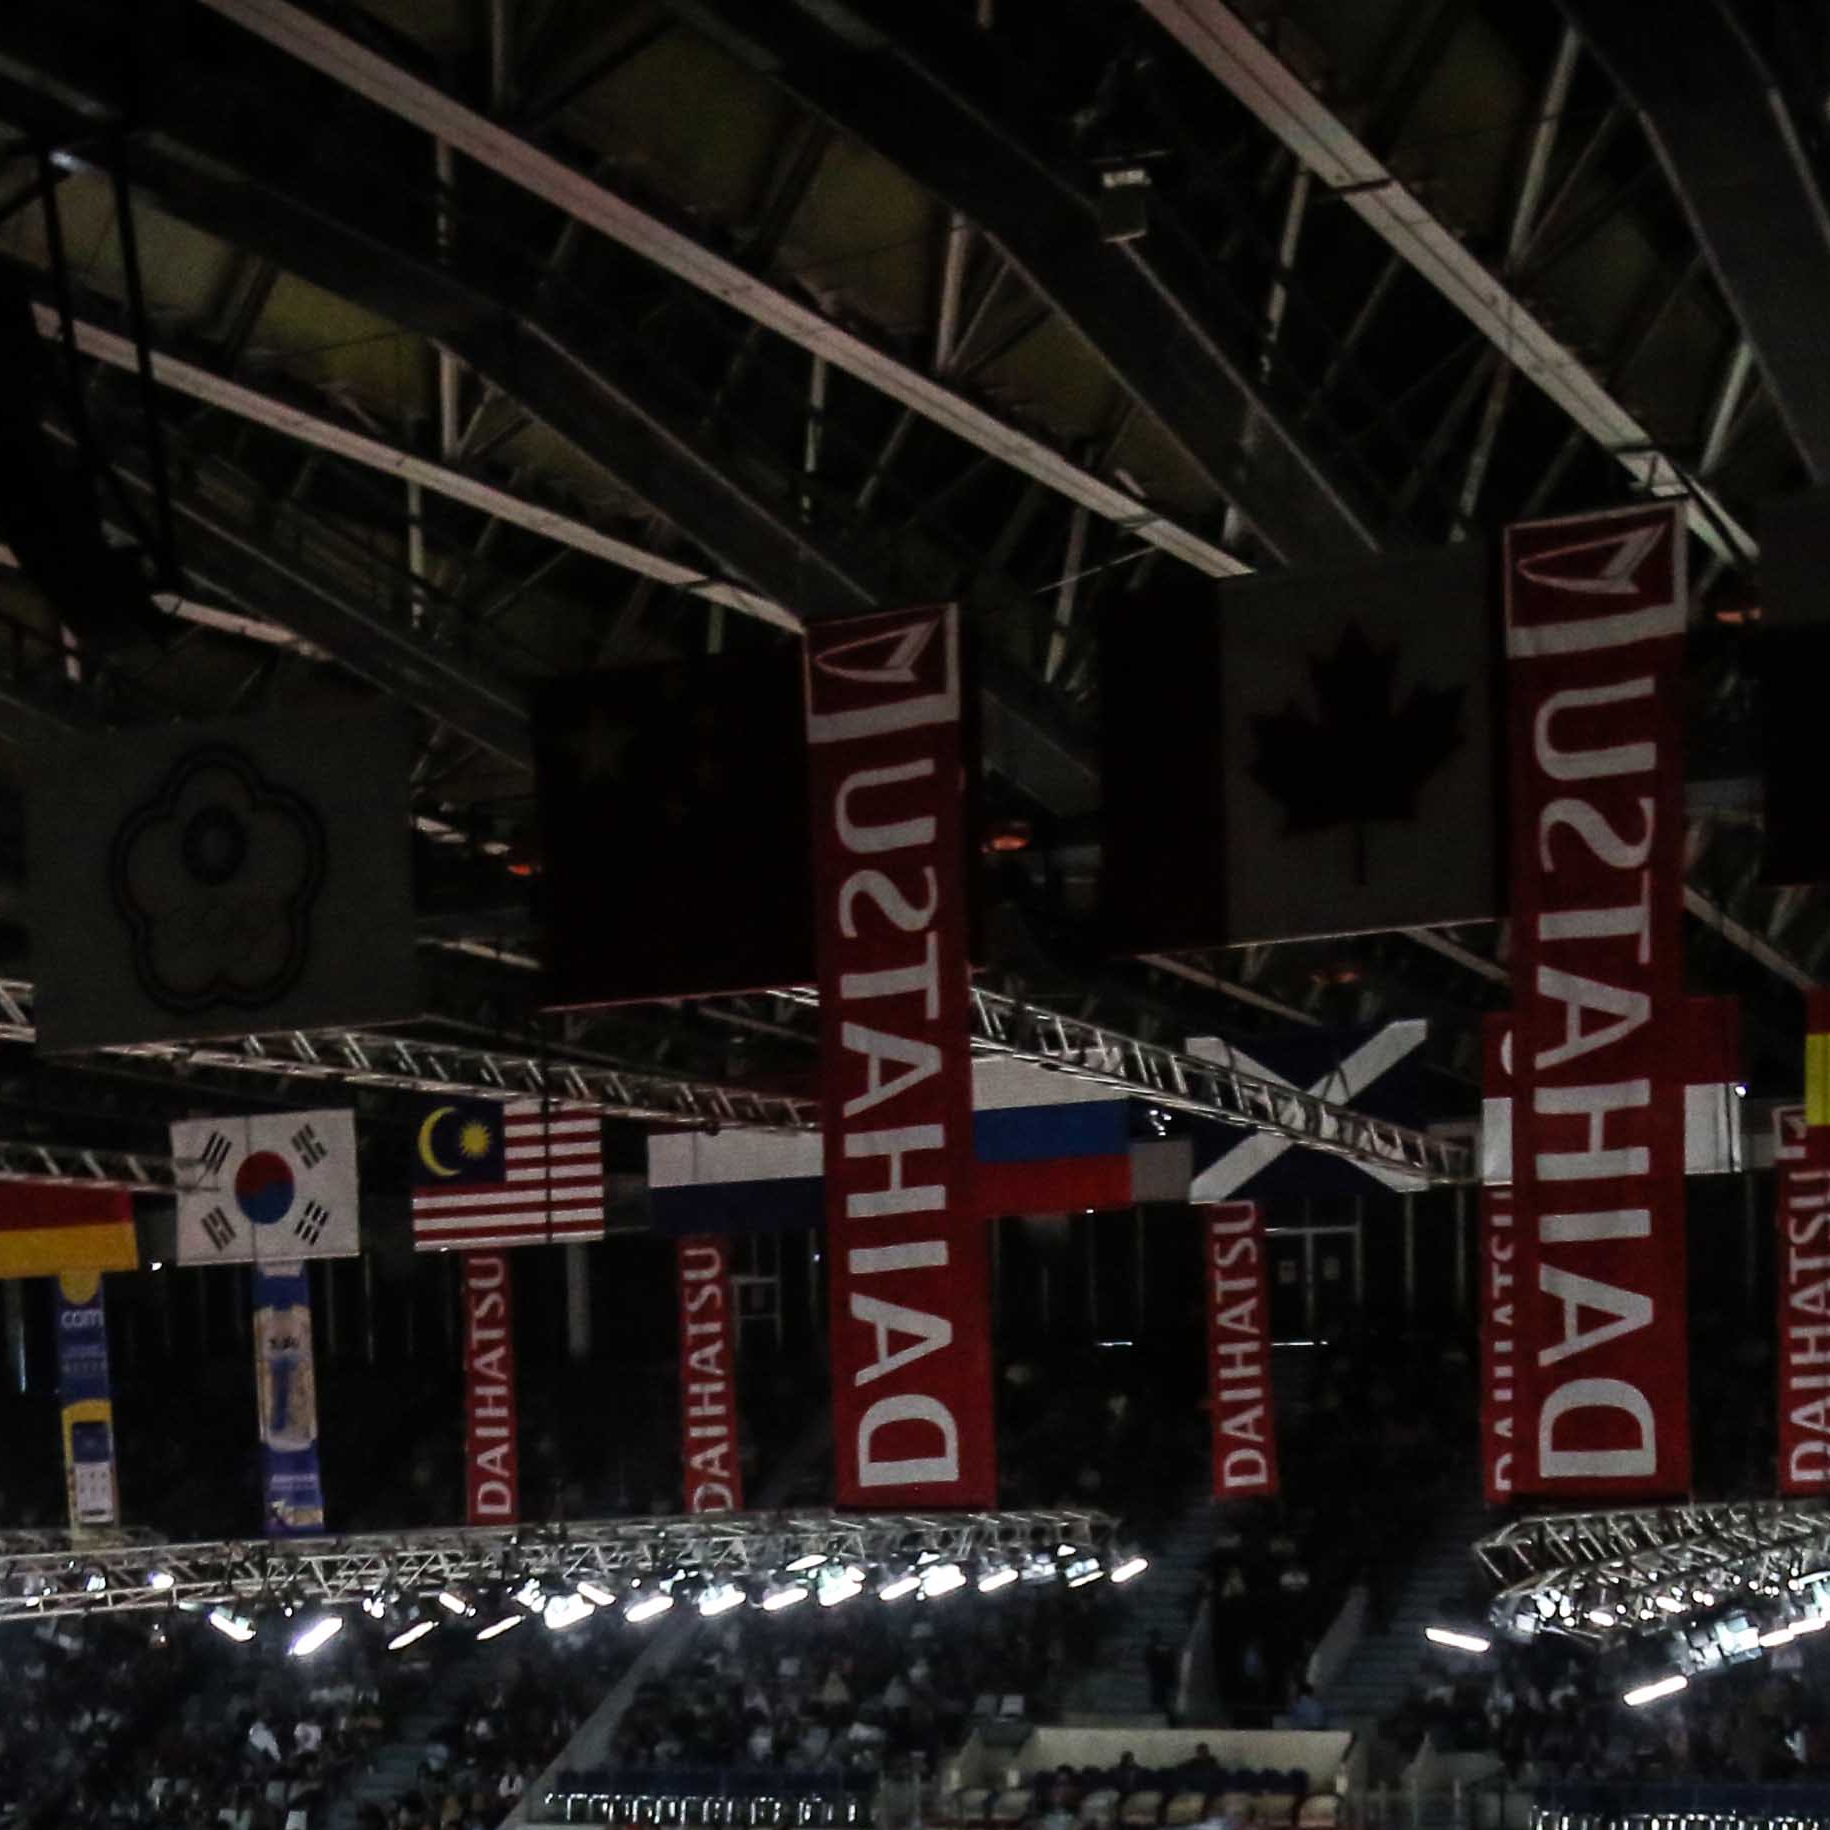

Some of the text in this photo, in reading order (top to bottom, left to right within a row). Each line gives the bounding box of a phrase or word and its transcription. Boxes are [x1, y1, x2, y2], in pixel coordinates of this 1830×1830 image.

[467, 1256, 513, 1516] DAIHATSU
[682, 1245, 734, 1514] DAIHATSU
[1212, 1200, 1270, 1489] DAIHATSU
